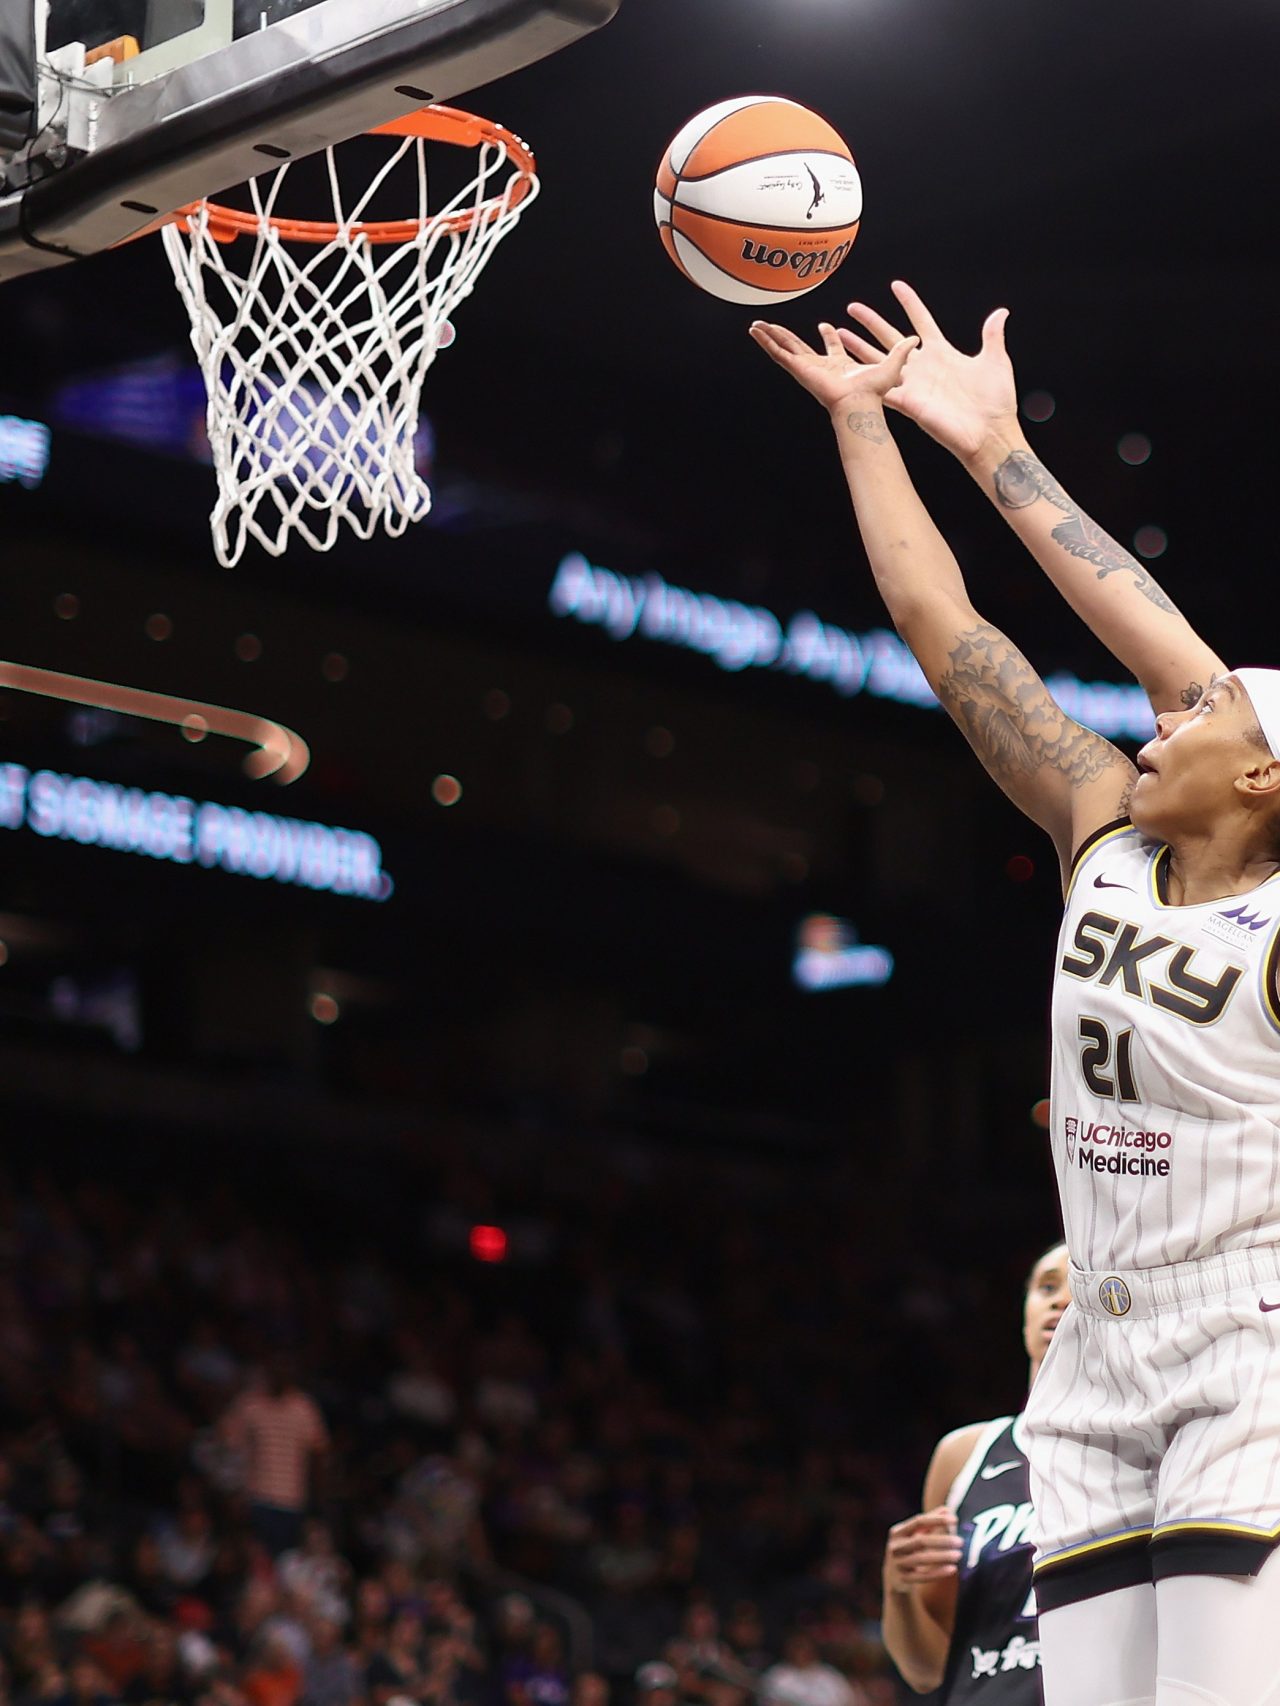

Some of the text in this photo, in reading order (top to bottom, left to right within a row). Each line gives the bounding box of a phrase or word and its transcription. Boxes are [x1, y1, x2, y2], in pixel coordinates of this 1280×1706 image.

[741, 238, 852, 279] Wilson
[1207, 915, 1255, 944] MAGELLAN
[1061, 909, 1248, 1028] SKY
[1078, 1014, 1142, 1104] 21
[1081, 1120, 1172, 1152] UChicago
[1079, 1148, 1170, 1177] Medicine
[963, 1502, 1036, 1574] PH
